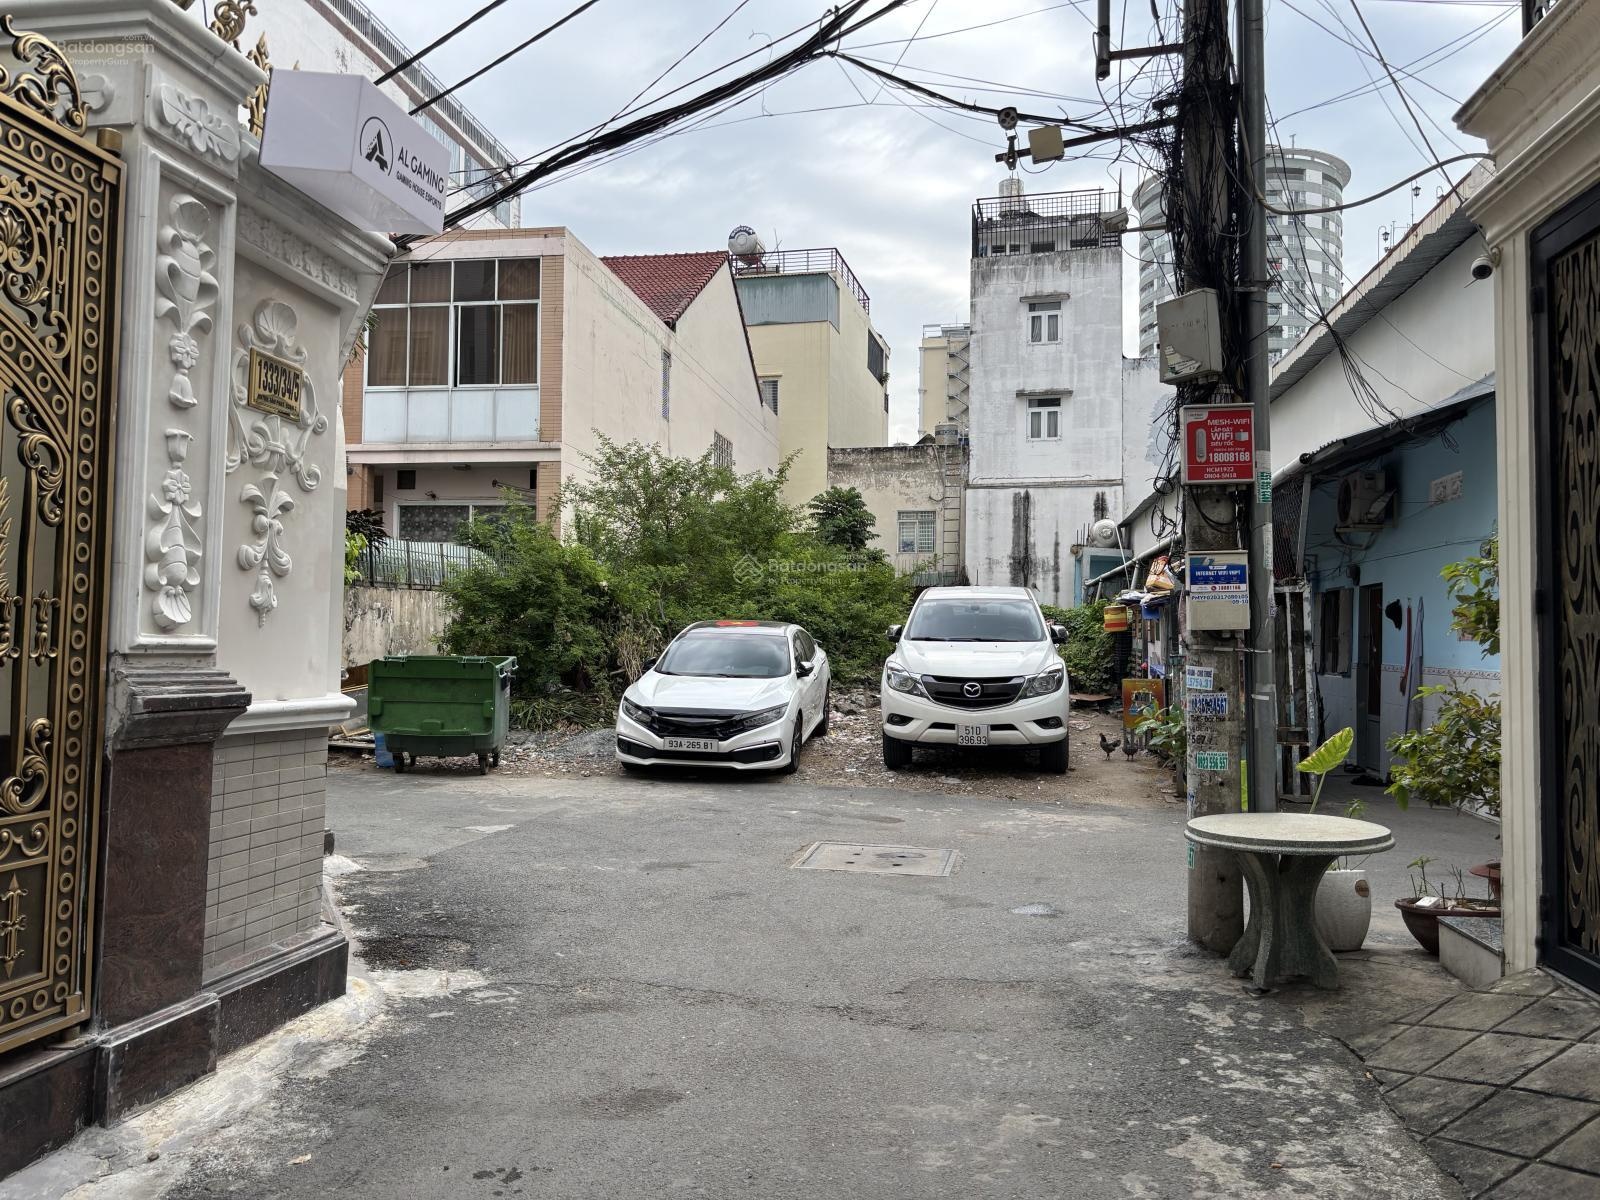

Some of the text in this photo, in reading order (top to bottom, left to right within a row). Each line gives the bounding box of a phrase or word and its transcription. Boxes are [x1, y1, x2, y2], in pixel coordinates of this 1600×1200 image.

[410, 156, 444, 194] GAMING
[258, 359, 300, 403] 1333/34/5
[1207, 418, 1250, 426] MESH-WIFI
[1211, 431, 1234, 441] WIFI
[1208, 452, 1250, 463] 18008168
[964, 726, 981, 735] 51D
[959, 735, 987, 745] 396.93
